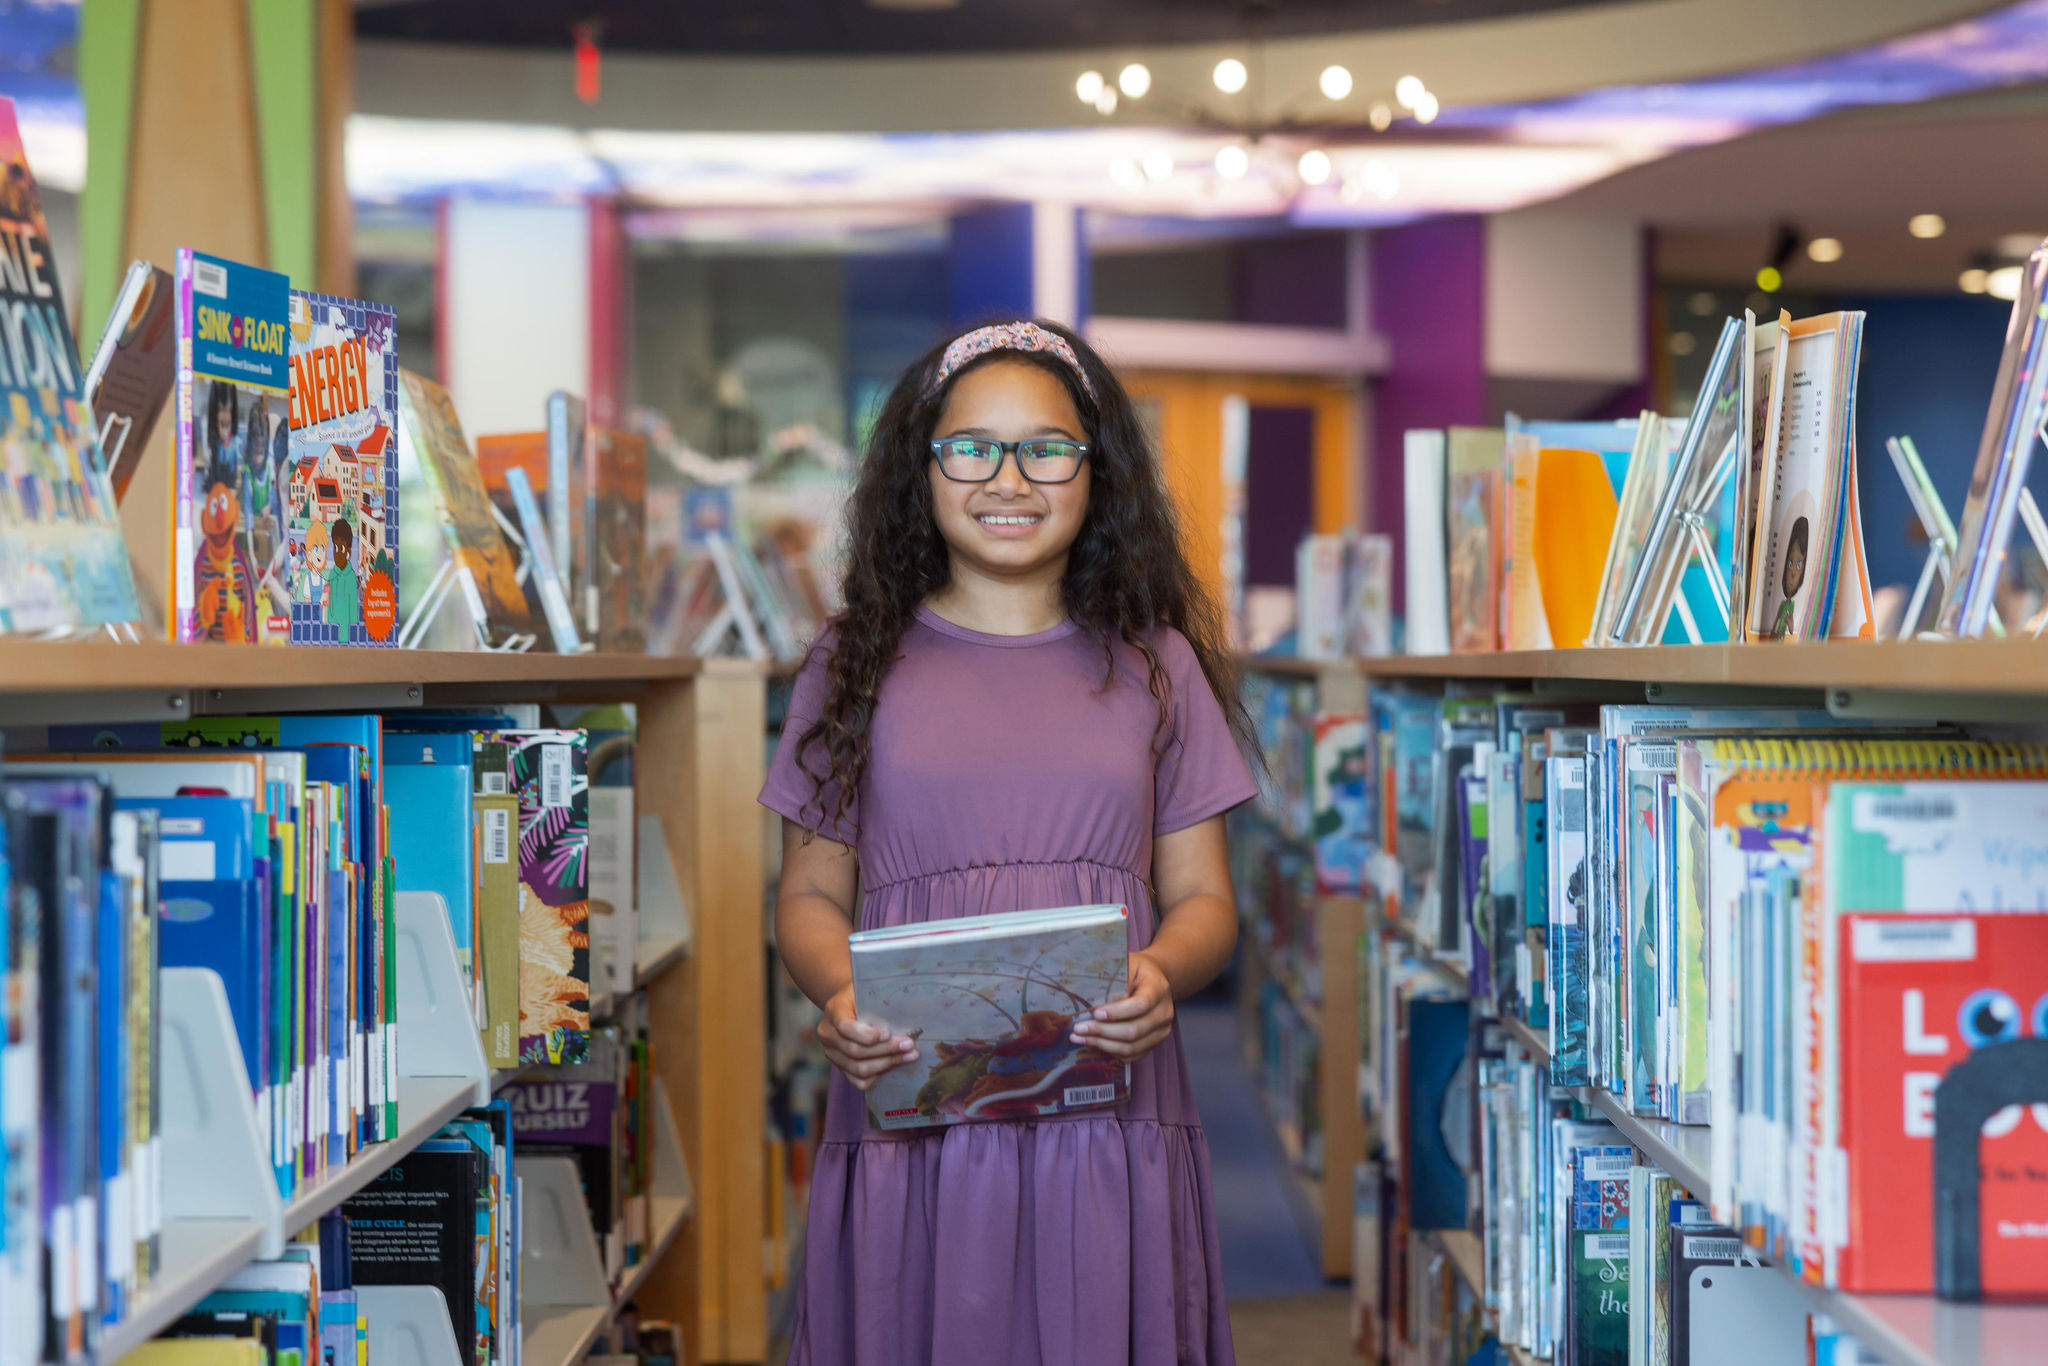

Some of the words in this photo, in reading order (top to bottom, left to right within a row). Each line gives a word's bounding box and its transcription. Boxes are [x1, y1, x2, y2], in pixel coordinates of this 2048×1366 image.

[198, 304, 232, 344] SINK
[244, 316, 285, 356] FLOAT
[289, 335, 369, 432] ENERGY
[511, 1110, 591, 1131] URSELF
[351, 1219, 373, 1228] ATER
